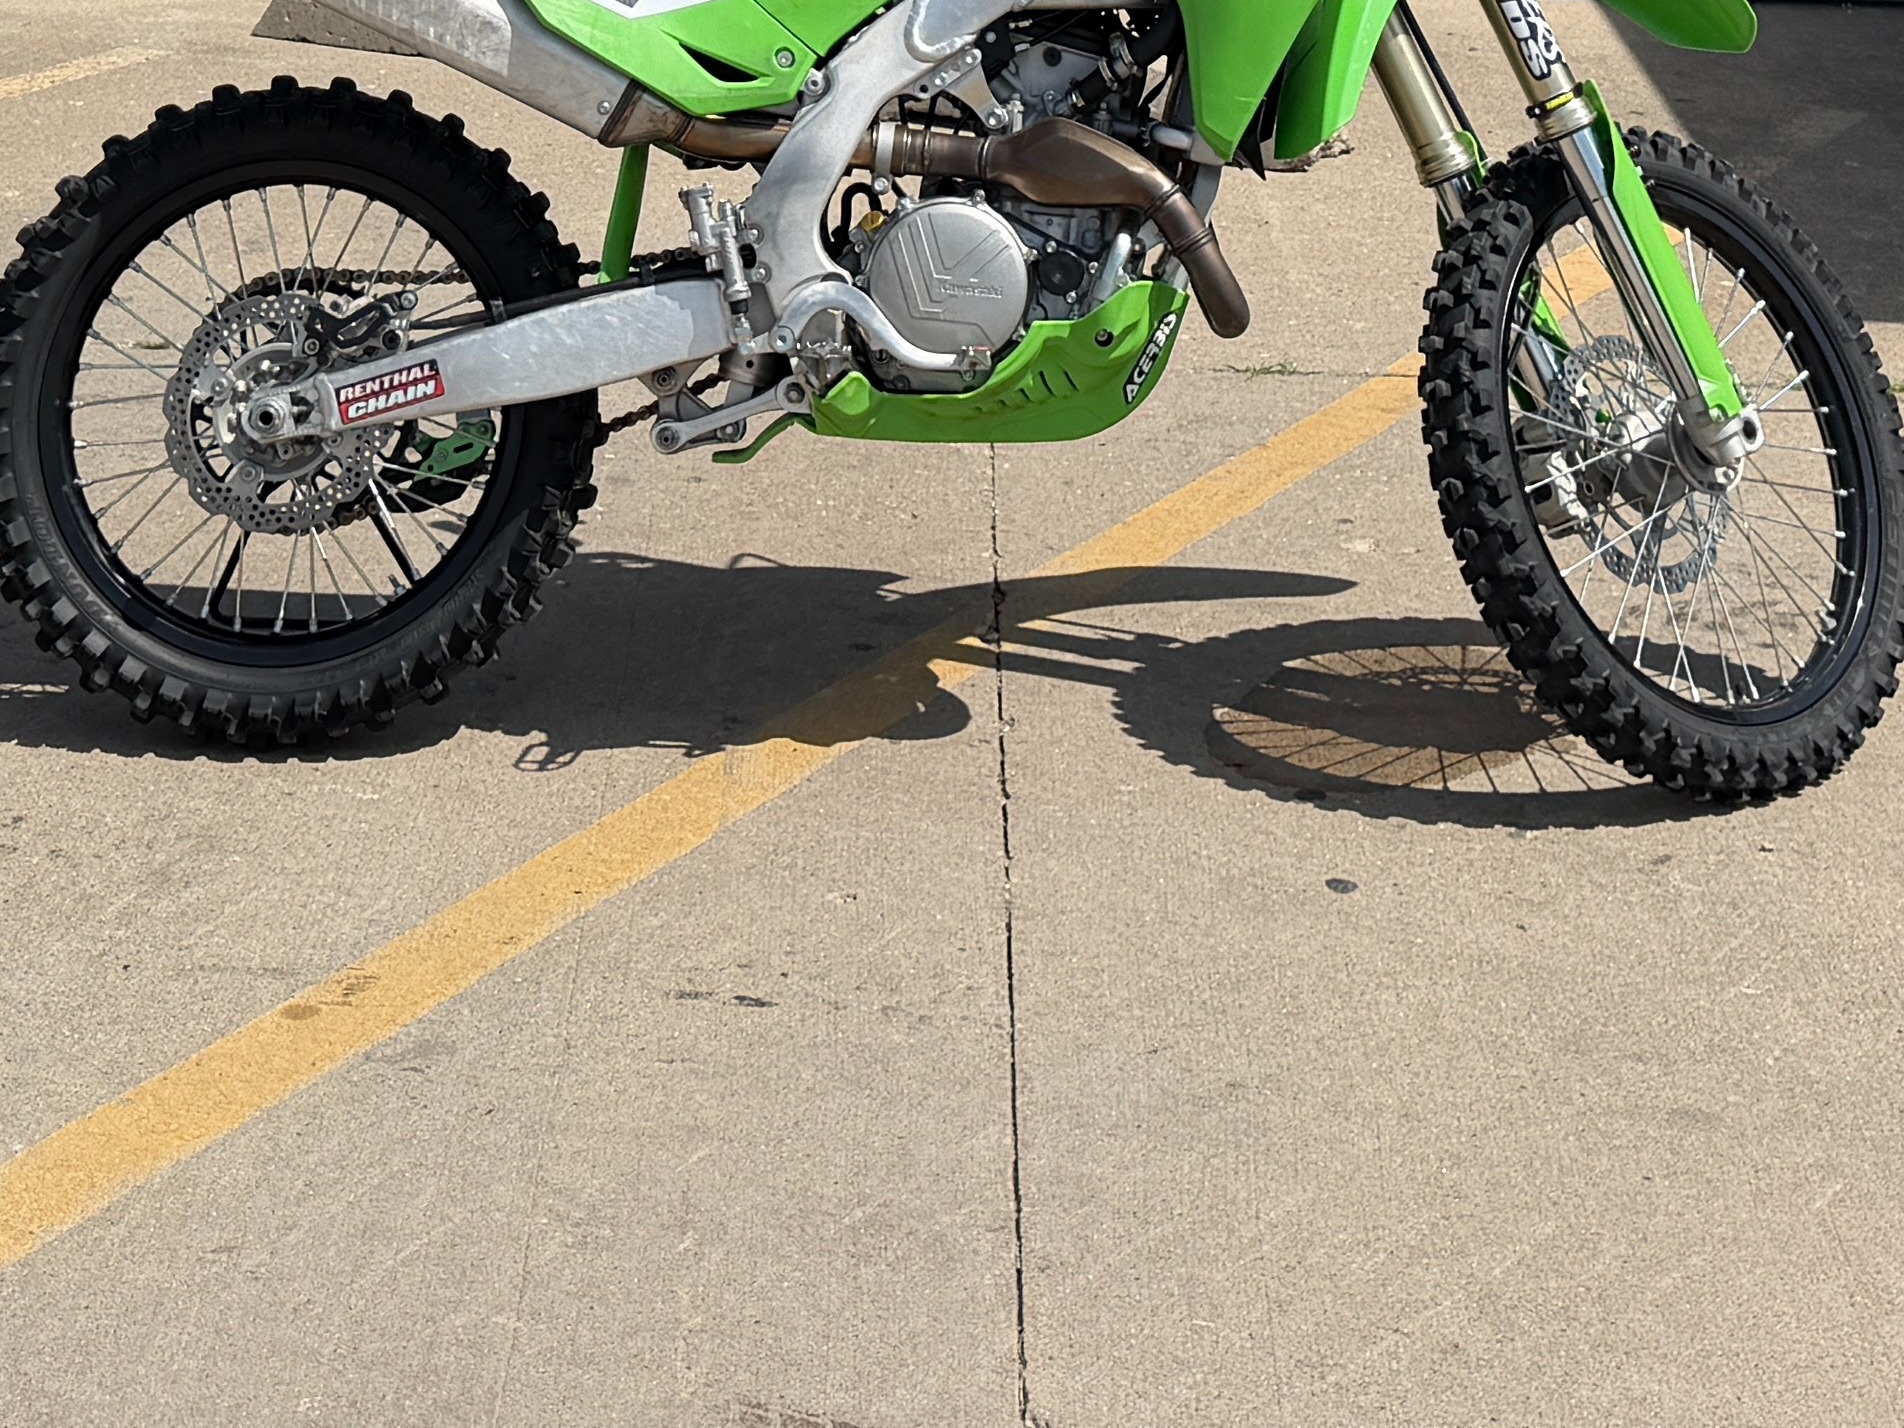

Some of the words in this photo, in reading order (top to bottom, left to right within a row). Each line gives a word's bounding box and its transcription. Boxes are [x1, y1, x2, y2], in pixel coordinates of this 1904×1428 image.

[1125, 312, 1178, 403] ACERBIS
[339, 363, 436, 403] RENTHAL
[347, 379, 436, 419] CHAIN
